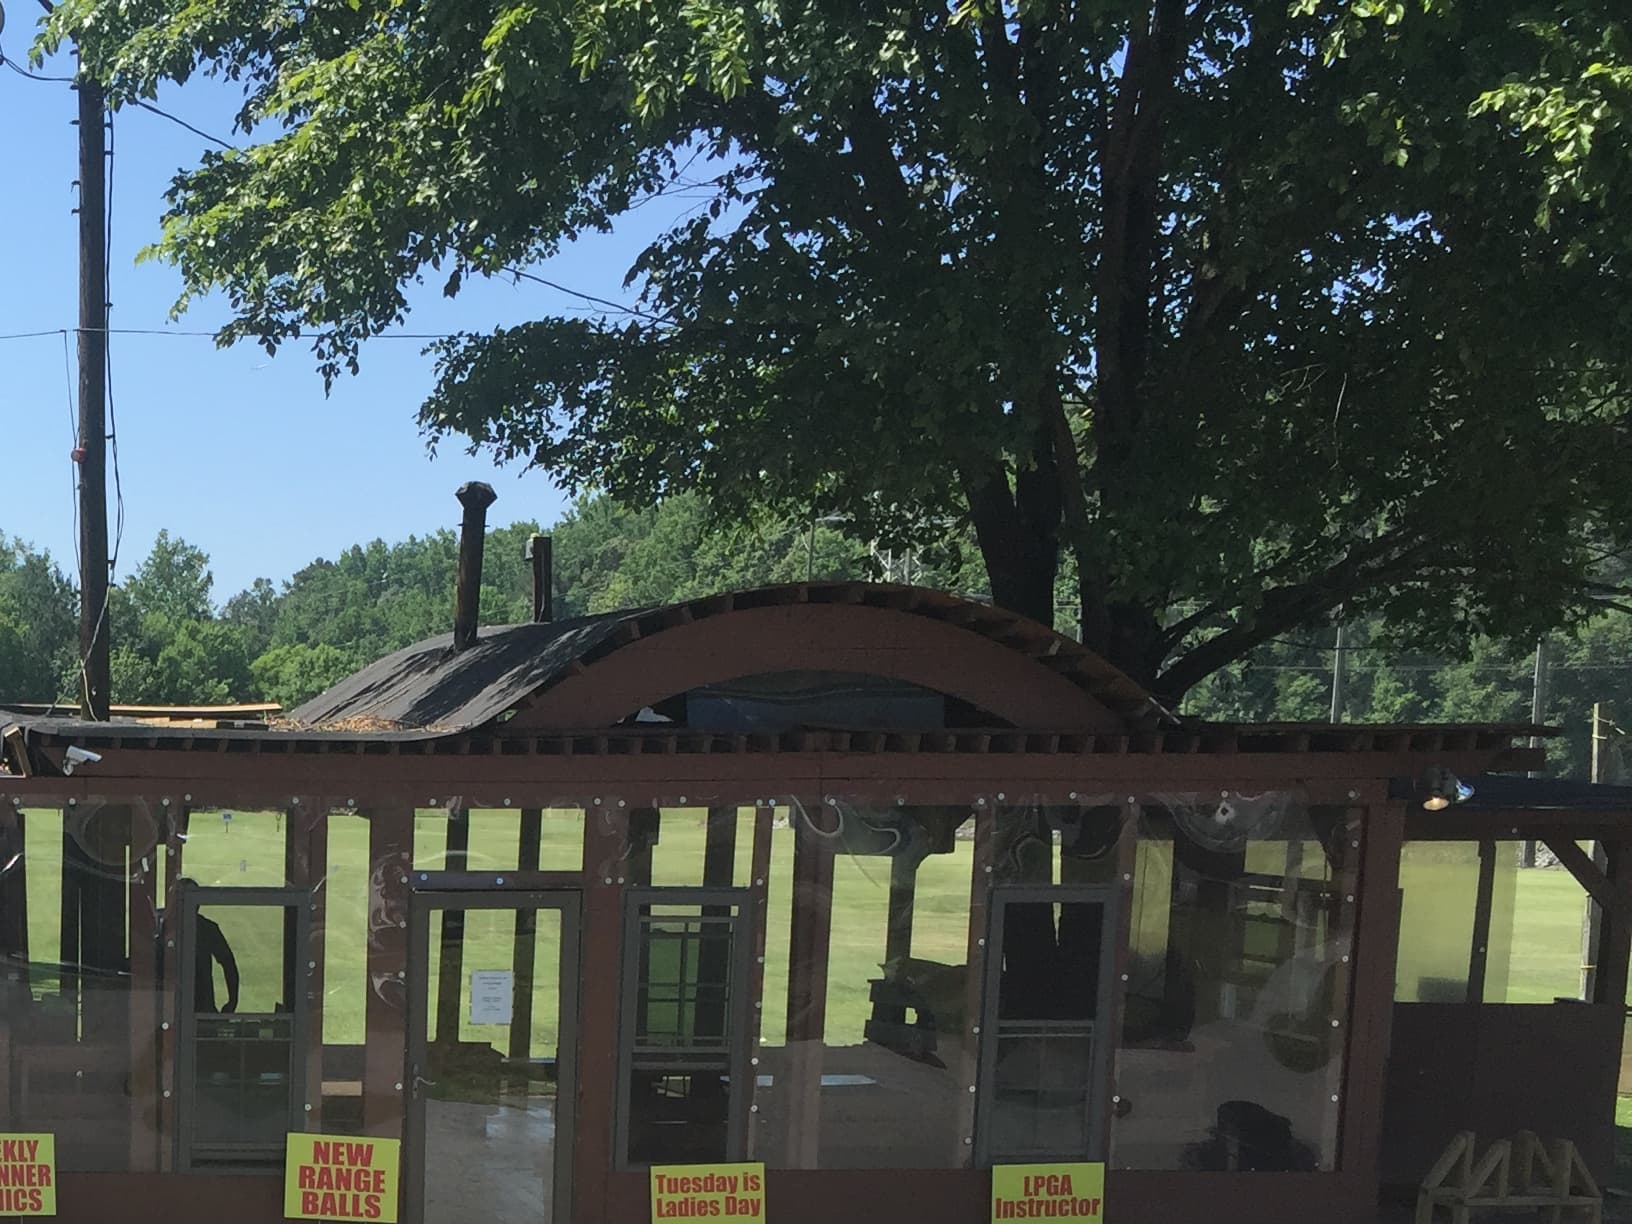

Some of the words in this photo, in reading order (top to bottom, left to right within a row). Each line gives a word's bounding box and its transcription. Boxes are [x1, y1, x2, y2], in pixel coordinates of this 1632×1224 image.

[313, 1140, 374, 1168] NEW
[298, 1165, 386, 1194] RANGE
[654, 1173, 739, 1195] Tuesday
[743, 1171, 762, 1192] is
[1023, 1173, 1073, 1197] LPGA
[302, 1190, 381, 1219] BALLS
[655, 1196, 721, 1219] Ladies
[724, 1195, 761, 1217] Day
[995, 1196, 1101, 1219] Instructor
